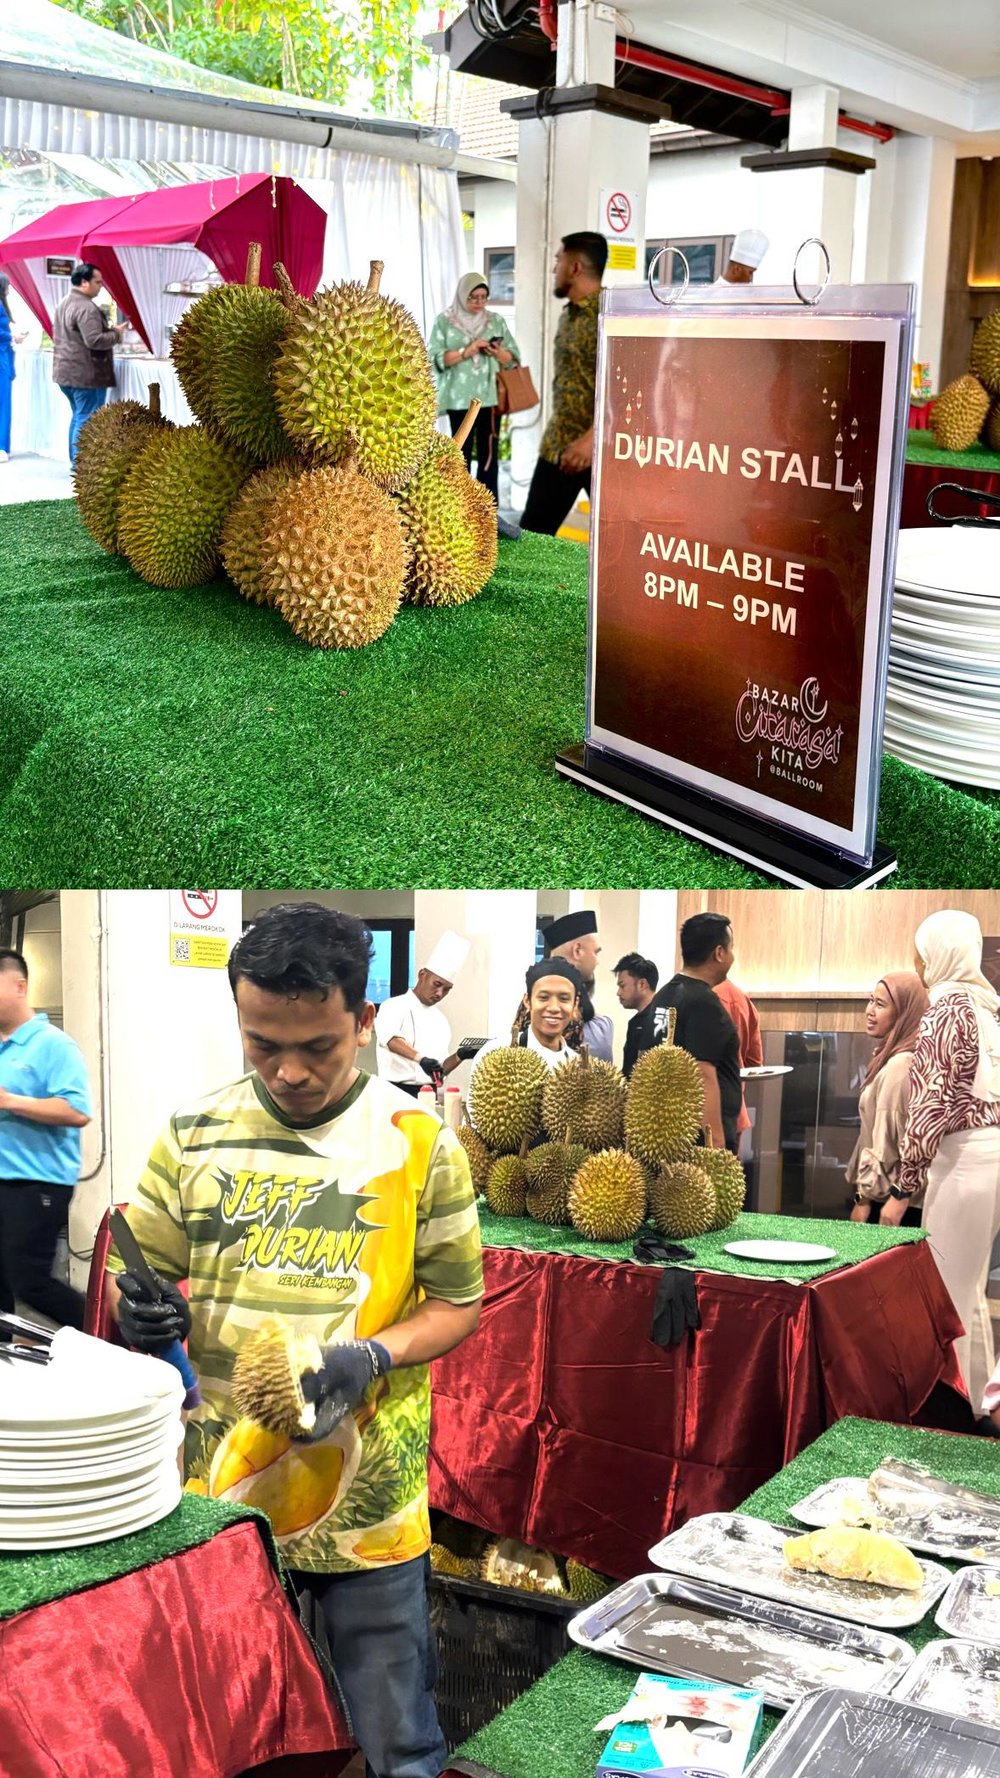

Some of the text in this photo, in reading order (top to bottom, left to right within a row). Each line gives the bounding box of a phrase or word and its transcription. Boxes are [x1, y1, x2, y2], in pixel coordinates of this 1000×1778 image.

[614, 432, 856, 493] DURIAN STALL
[640, 531, 806, 593] AVAILABLE
[644, 571, 699, 609] 8PM
[733, 594, 798, 636] 9PM
[752, 683, 799, 713] BAZAR
[769, 764, 823, 792] @BALLROOM
[771, 745, 803, 771] KITA
[222, 1170, 325, 1220] JEFF
[242, 1223, 367, 1274] DURIAN
[277, 1273, 353, 1292] SERI KEMBANGAN
